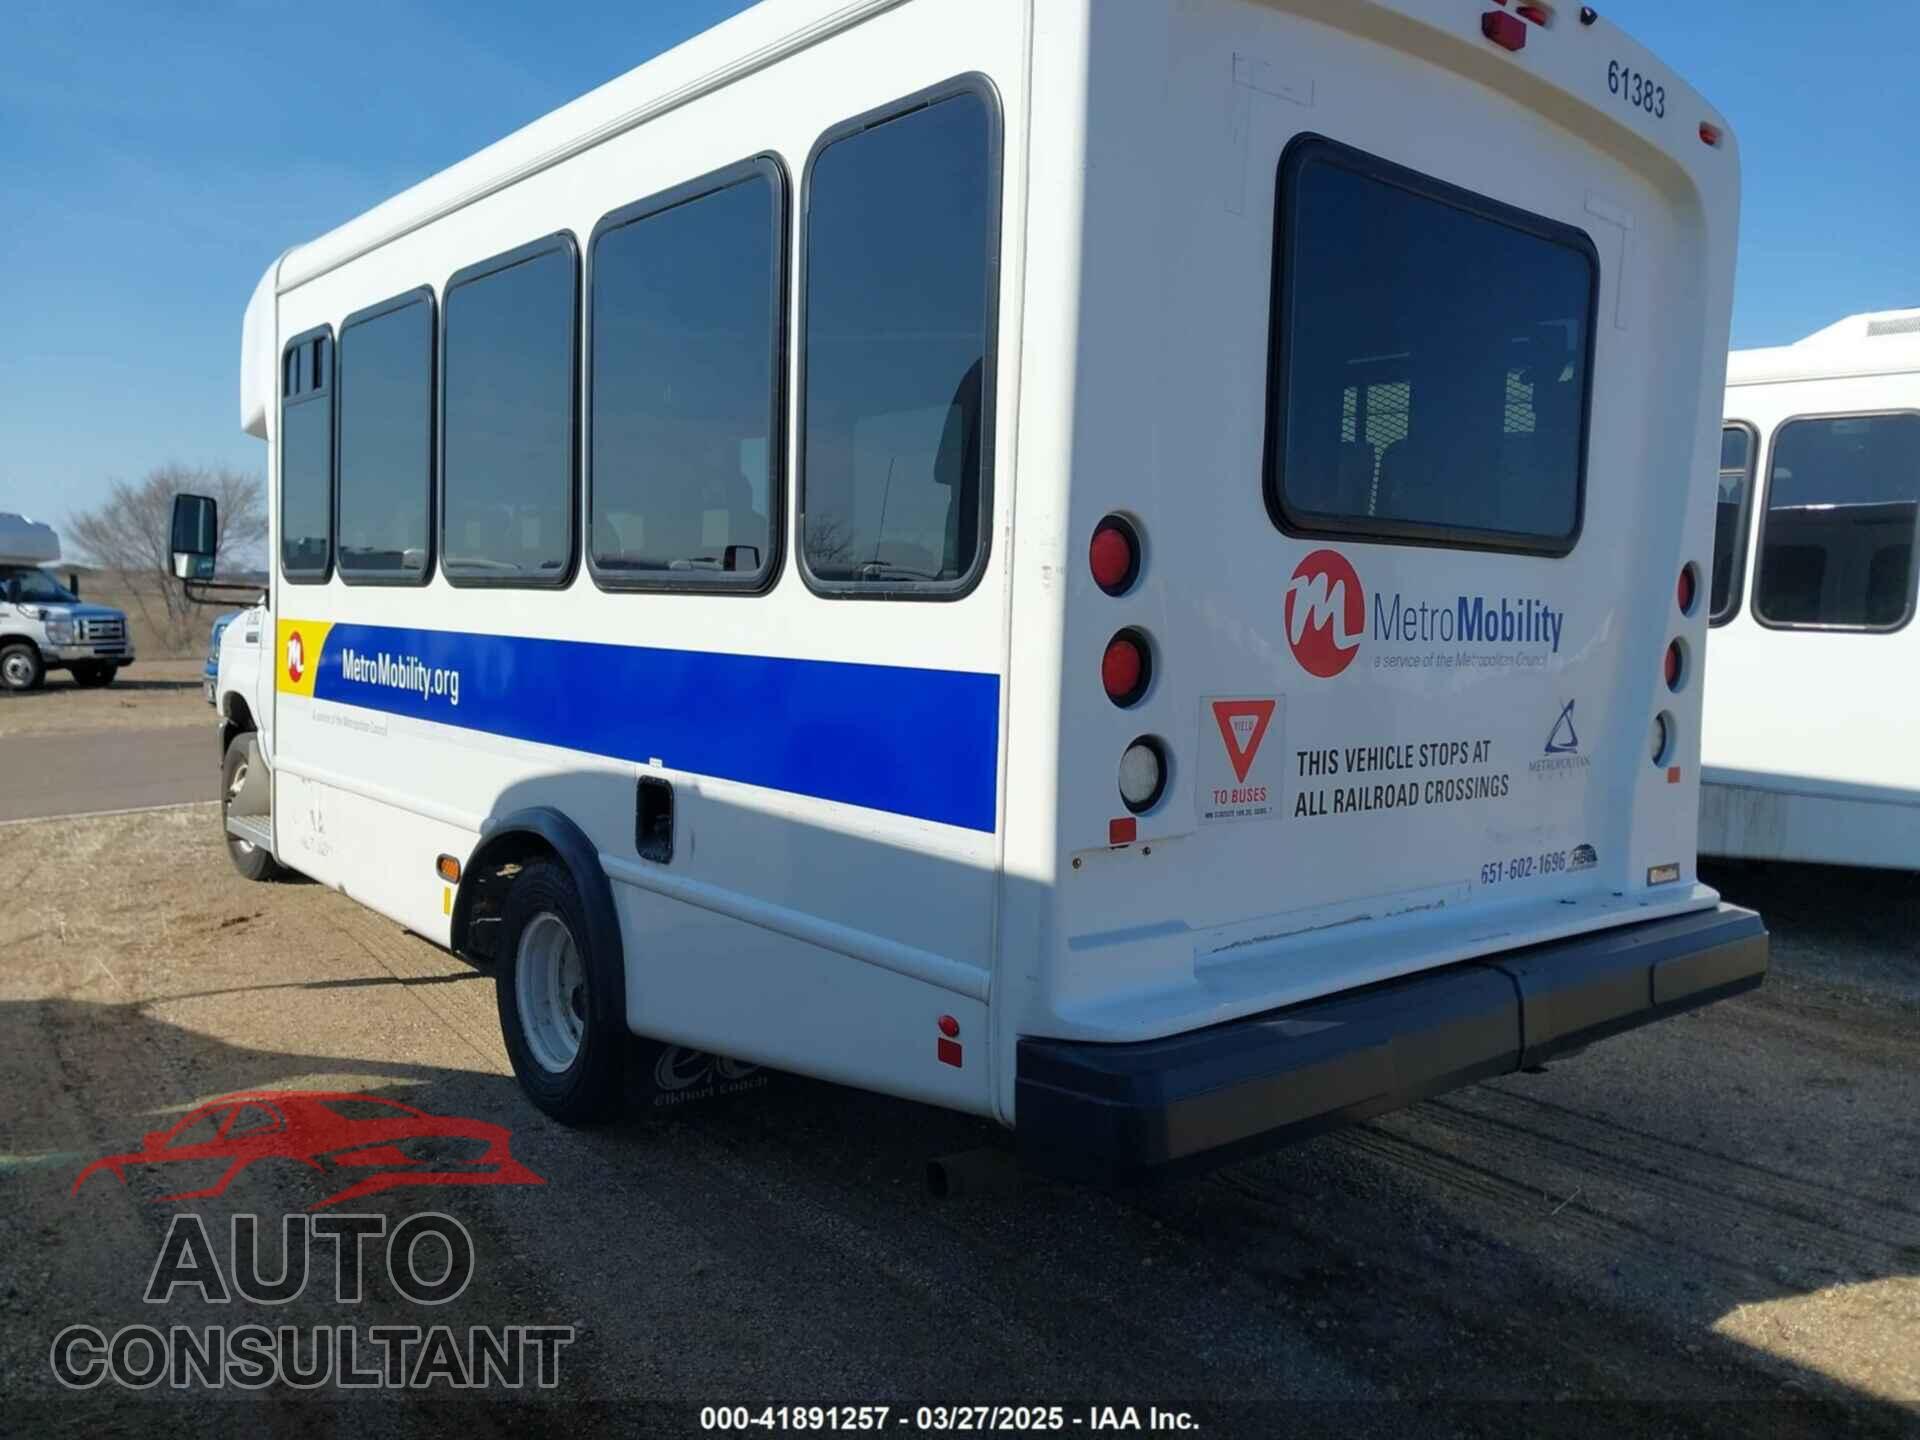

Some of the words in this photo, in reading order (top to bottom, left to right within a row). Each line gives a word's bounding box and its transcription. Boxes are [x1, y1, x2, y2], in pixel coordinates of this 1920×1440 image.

[1608, 60, 1665, 119] 61383
[1374, 592, 1563, 653] MetroMobility
[342, 648, 459, 706] MetroMobility.org
[1423, 652, 1434, 667] of
[1437, 652, 1453, 667] the
[1297, 749, 1339, 777] THIS
[1345, 745, 1414, 773] VEHICLE
[1419, 741, 1469, 768] STOPS
[1473, 740, 1492, 764] AT
[1214, 789, 1229, 805] TO
[1232, 787, 1267, 804] BUSES
[1294, 790, 1328, 818] ALL
[1333, 782, 1419, 814] RAILROAD
[1425, 774, 1509, 804] CROSSINGS
[1481, 850, 1566, 885] 651-602-1696
